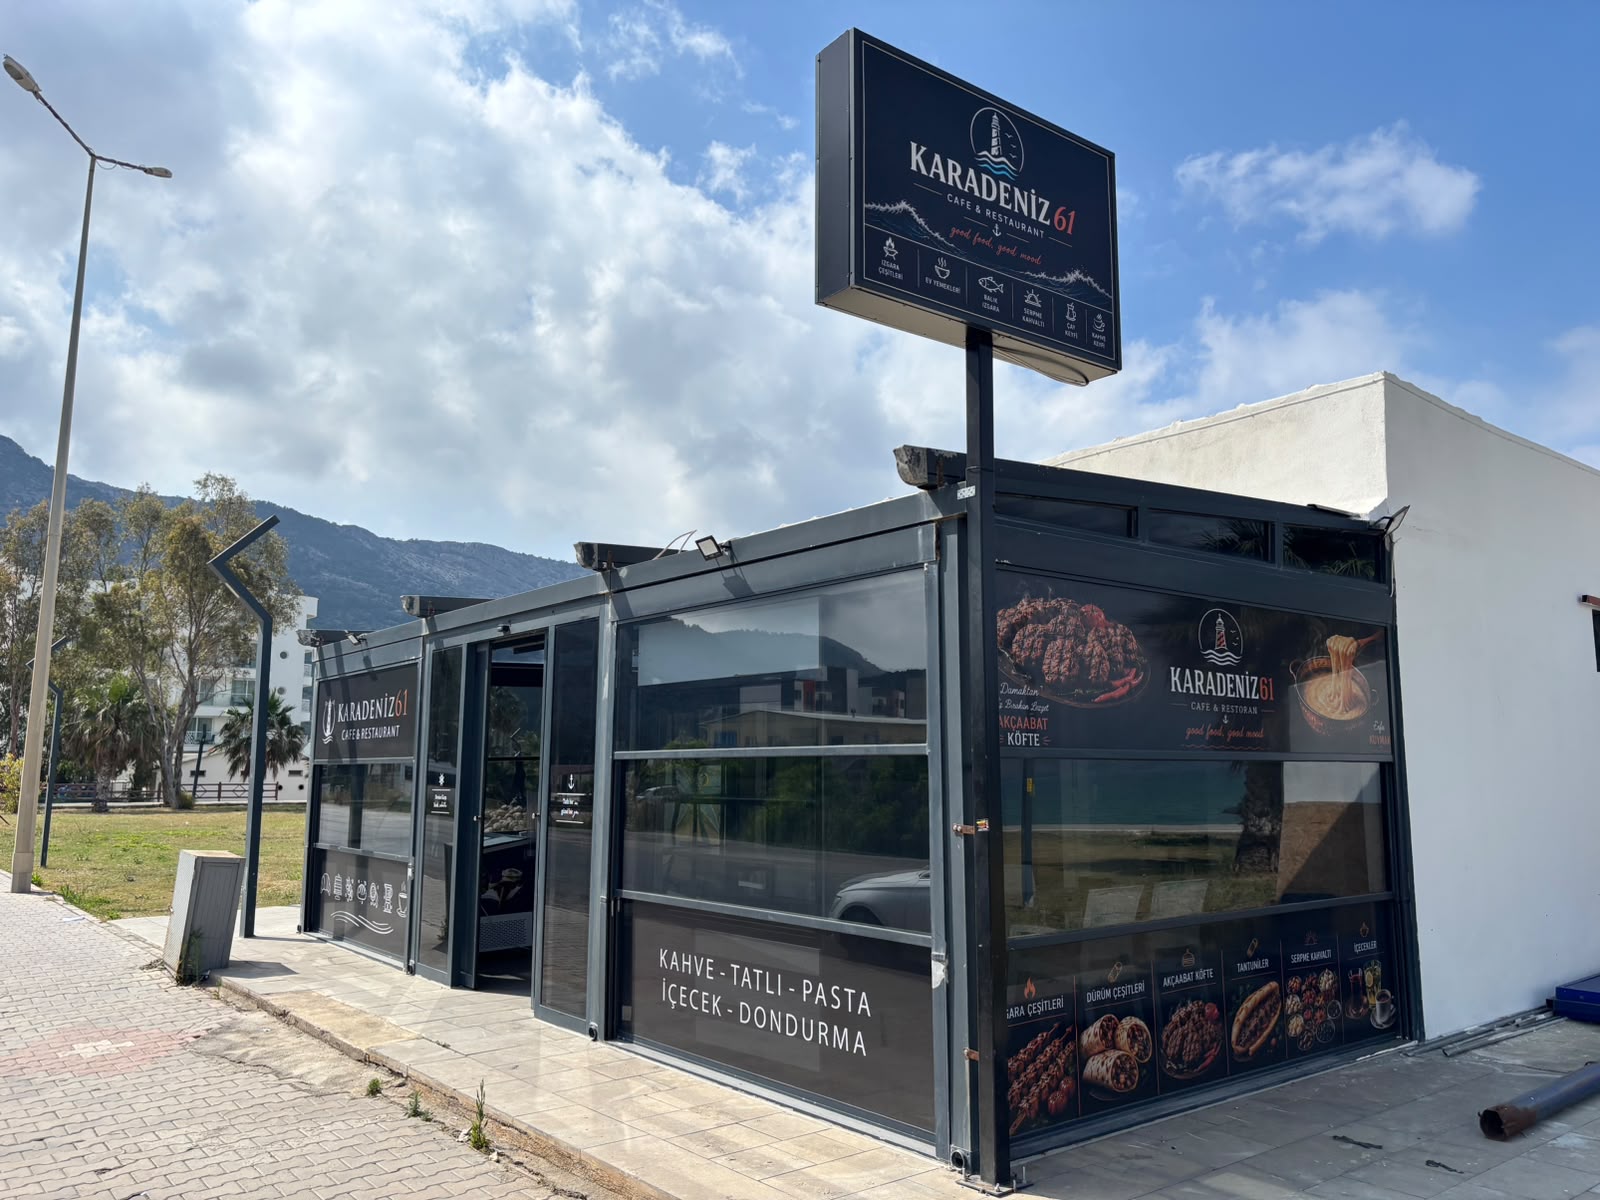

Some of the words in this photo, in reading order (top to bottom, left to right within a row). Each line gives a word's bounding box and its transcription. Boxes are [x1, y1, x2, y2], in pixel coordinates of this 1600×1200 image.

[910, 141, 1051, 226] KARADENİZ
[1053, 206, 1076, 235] 61
[946, 193, 972, 210] CAFE
[975, 204, 982, 214] &
[985, 208, 1045, 239] RESTAURANT
[949, 226, 972, 240] good
[996, 244, 1018, 257] good
[1019, 252, 1042, 265] mood
[925, 276, 932, 285] EV
[933, 278, 960, 294] YEMEKLERİ
[1023, 307, 1042, 319] SERPME
[1190, 701, 1211, 712] CAFE
[1213, 704, 1219, 712] &
[1221, 704, 1258, 715] RESTORAN
[999, 715, 1048, 732] AKÇAABAT
[1185, 724, 1205, 740] good
[1226, 726, 1245, 742] good
[1246, 727, 1265, 738] mood
[1007, 730, 1040, 746] KÖFTE
[1236, 958, 1269, 973] TANTUNİLER
[659, 948, 714, 980] KAHVE
[730, 963, 782, 996] TATLI
[802, 979, 871, 1017] PASTA
[1163, 971, 1194, 988] AKÇAABAT
[1195, 968, 1214, 981] KÖFTE
[1086, 989, 1112, 1003] DÜRÜM
[1113, 980, 1145, 1001] ÇEŞİTLERİ
[1027, 995, 1064, 1018] ÇEŞİTLERİ
[662, 977, 722, 1017] İÇECEK
[739, 1001, 867, 1057] DONDURMA
